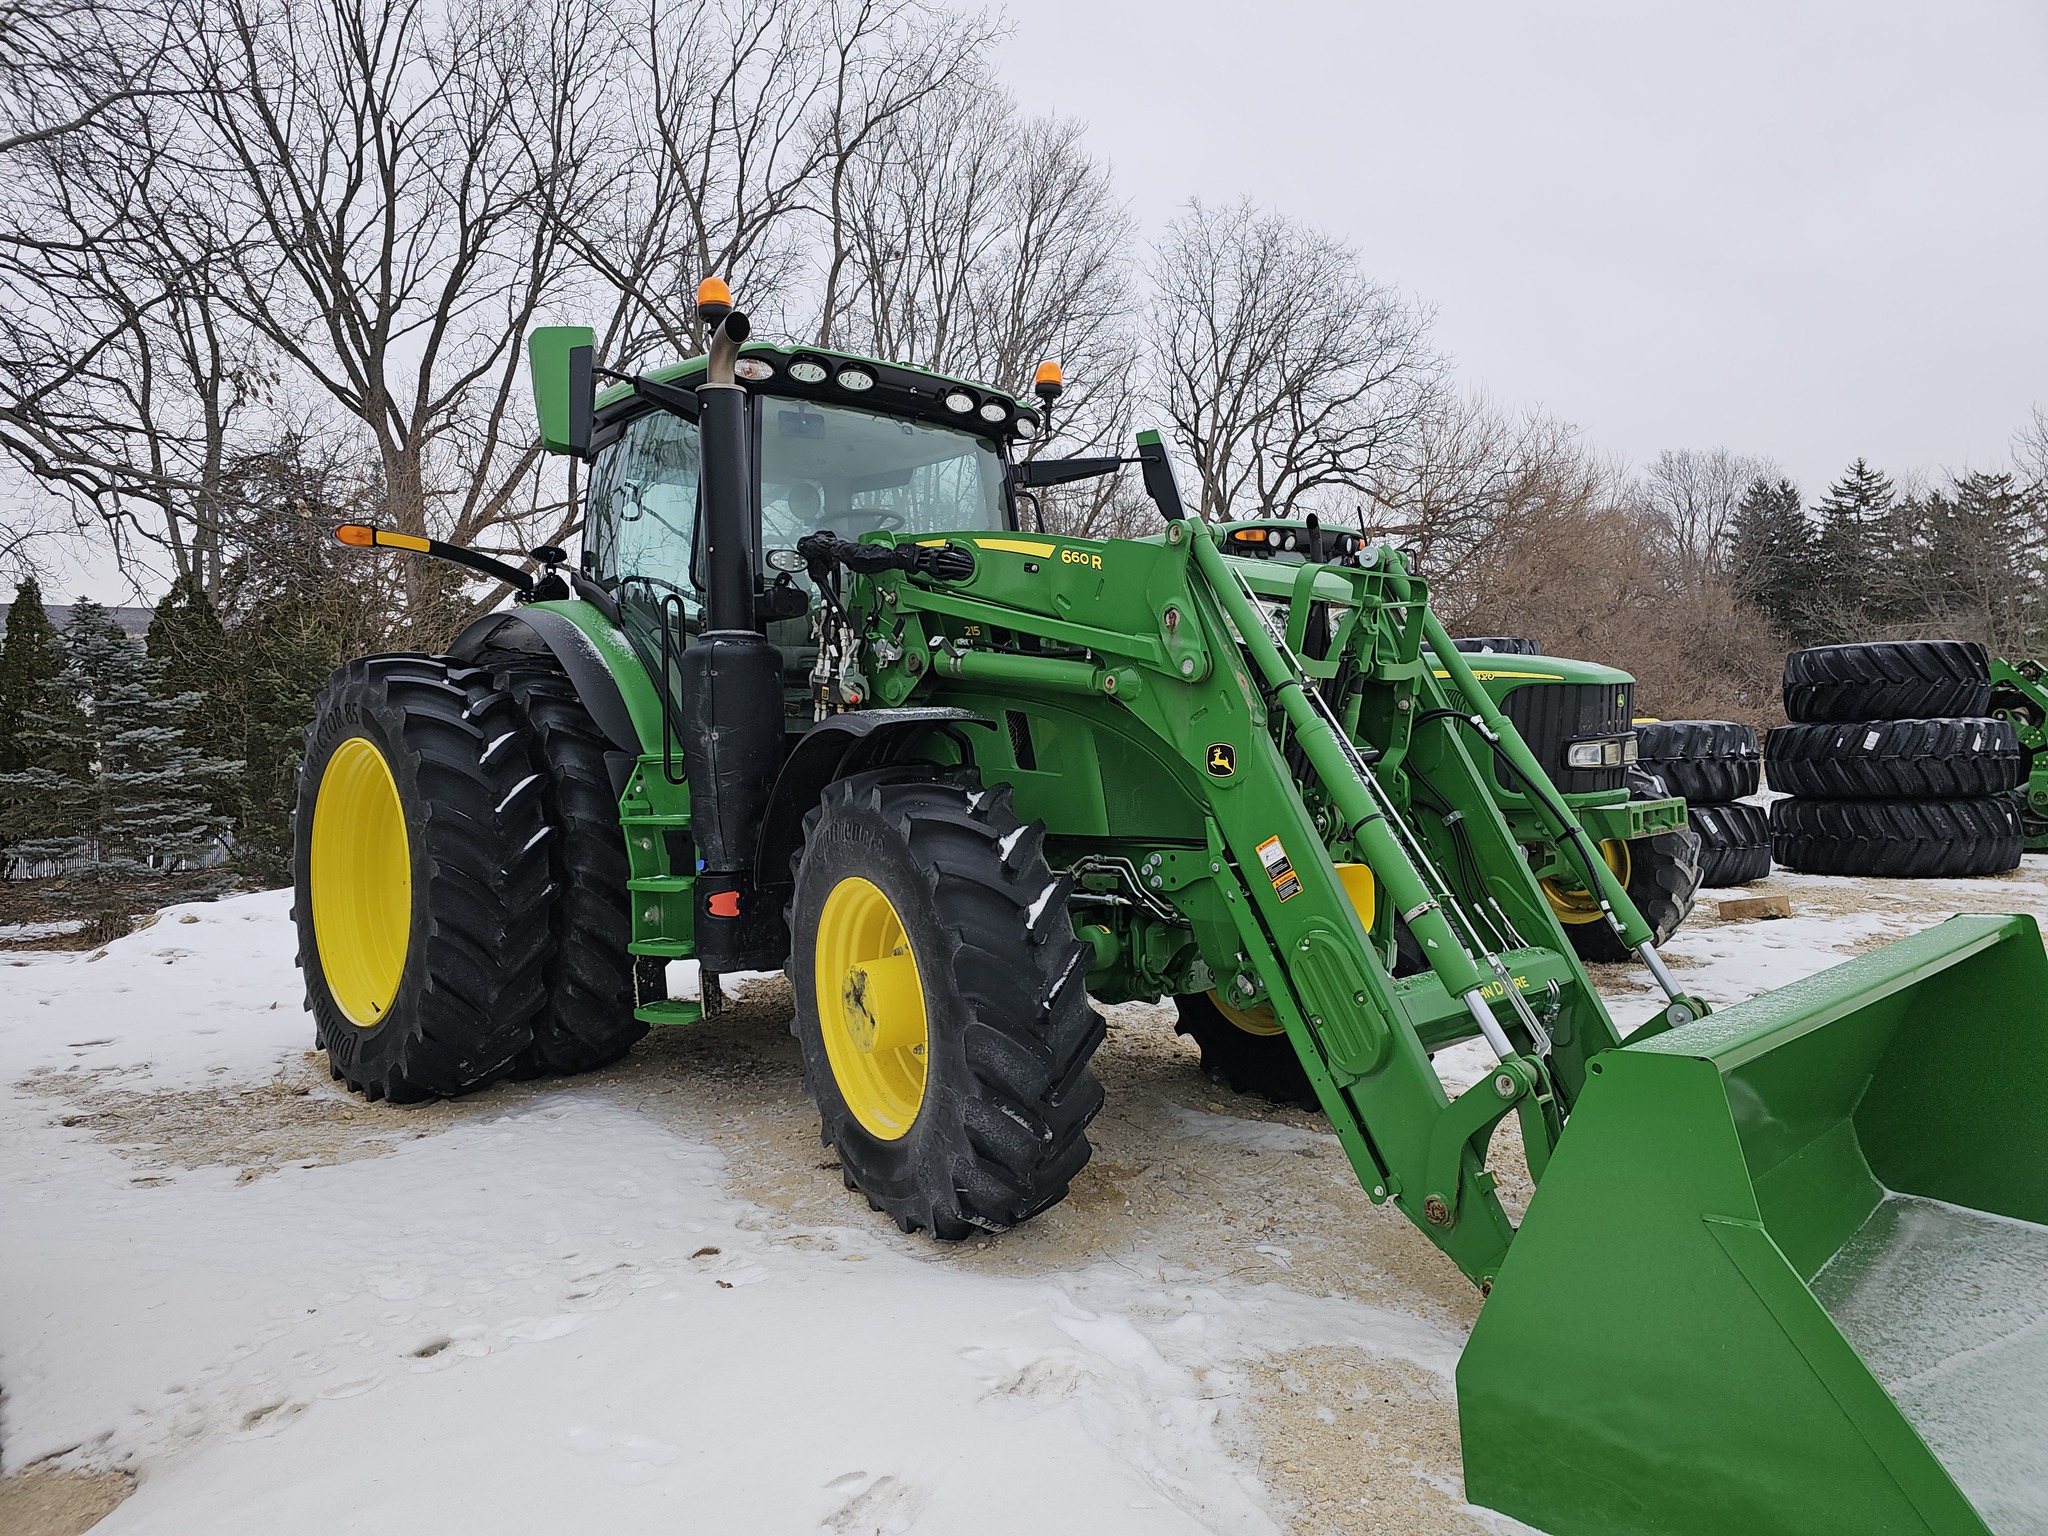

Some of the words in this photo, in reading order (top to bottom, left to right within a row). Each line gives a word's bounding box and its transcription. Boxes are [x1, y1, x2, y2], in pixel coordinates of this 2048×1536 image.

[963, 625, 981, 637] 215
[344, 702, 360, 725] 85
[1492, 976, 1529, 995] DRE
